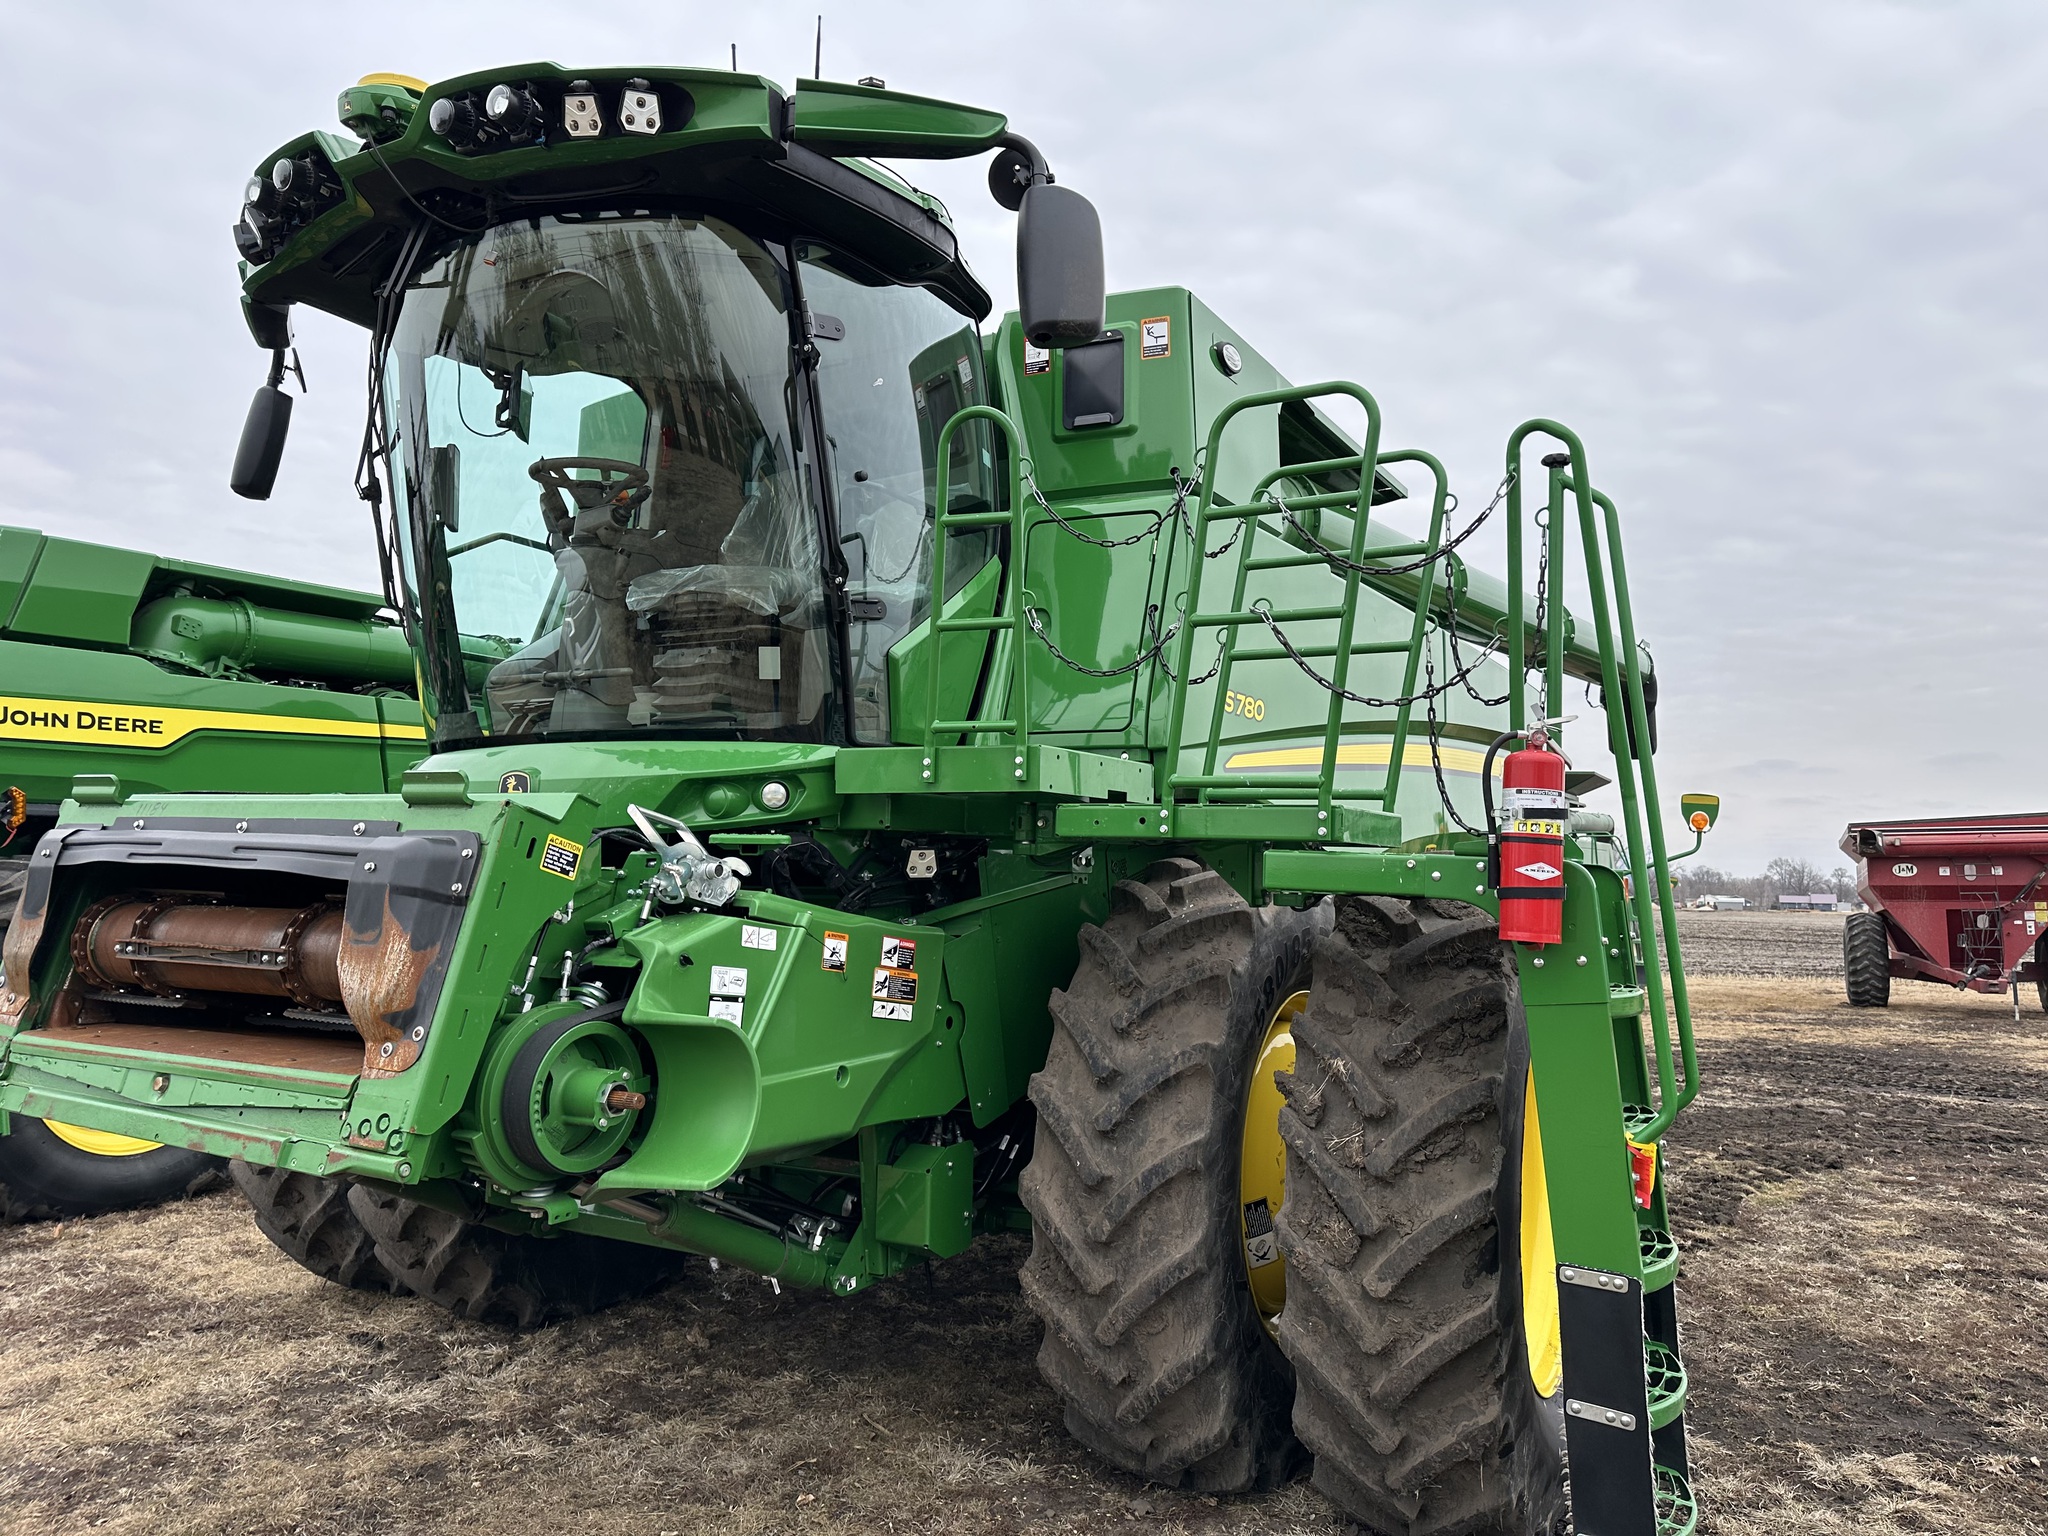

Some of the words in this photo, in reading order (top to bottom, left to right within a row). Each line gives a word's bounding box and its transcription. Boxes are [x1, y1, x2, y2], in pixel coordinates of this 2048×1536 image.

[1224, 689, 1265, 722] S780
[0, 706, 69, 728] JOHN
[77, 711, 163, 735] DEERE
[555, 838, 581, 853] CAUTION
[1894, 865, 1914, 875] J&M
